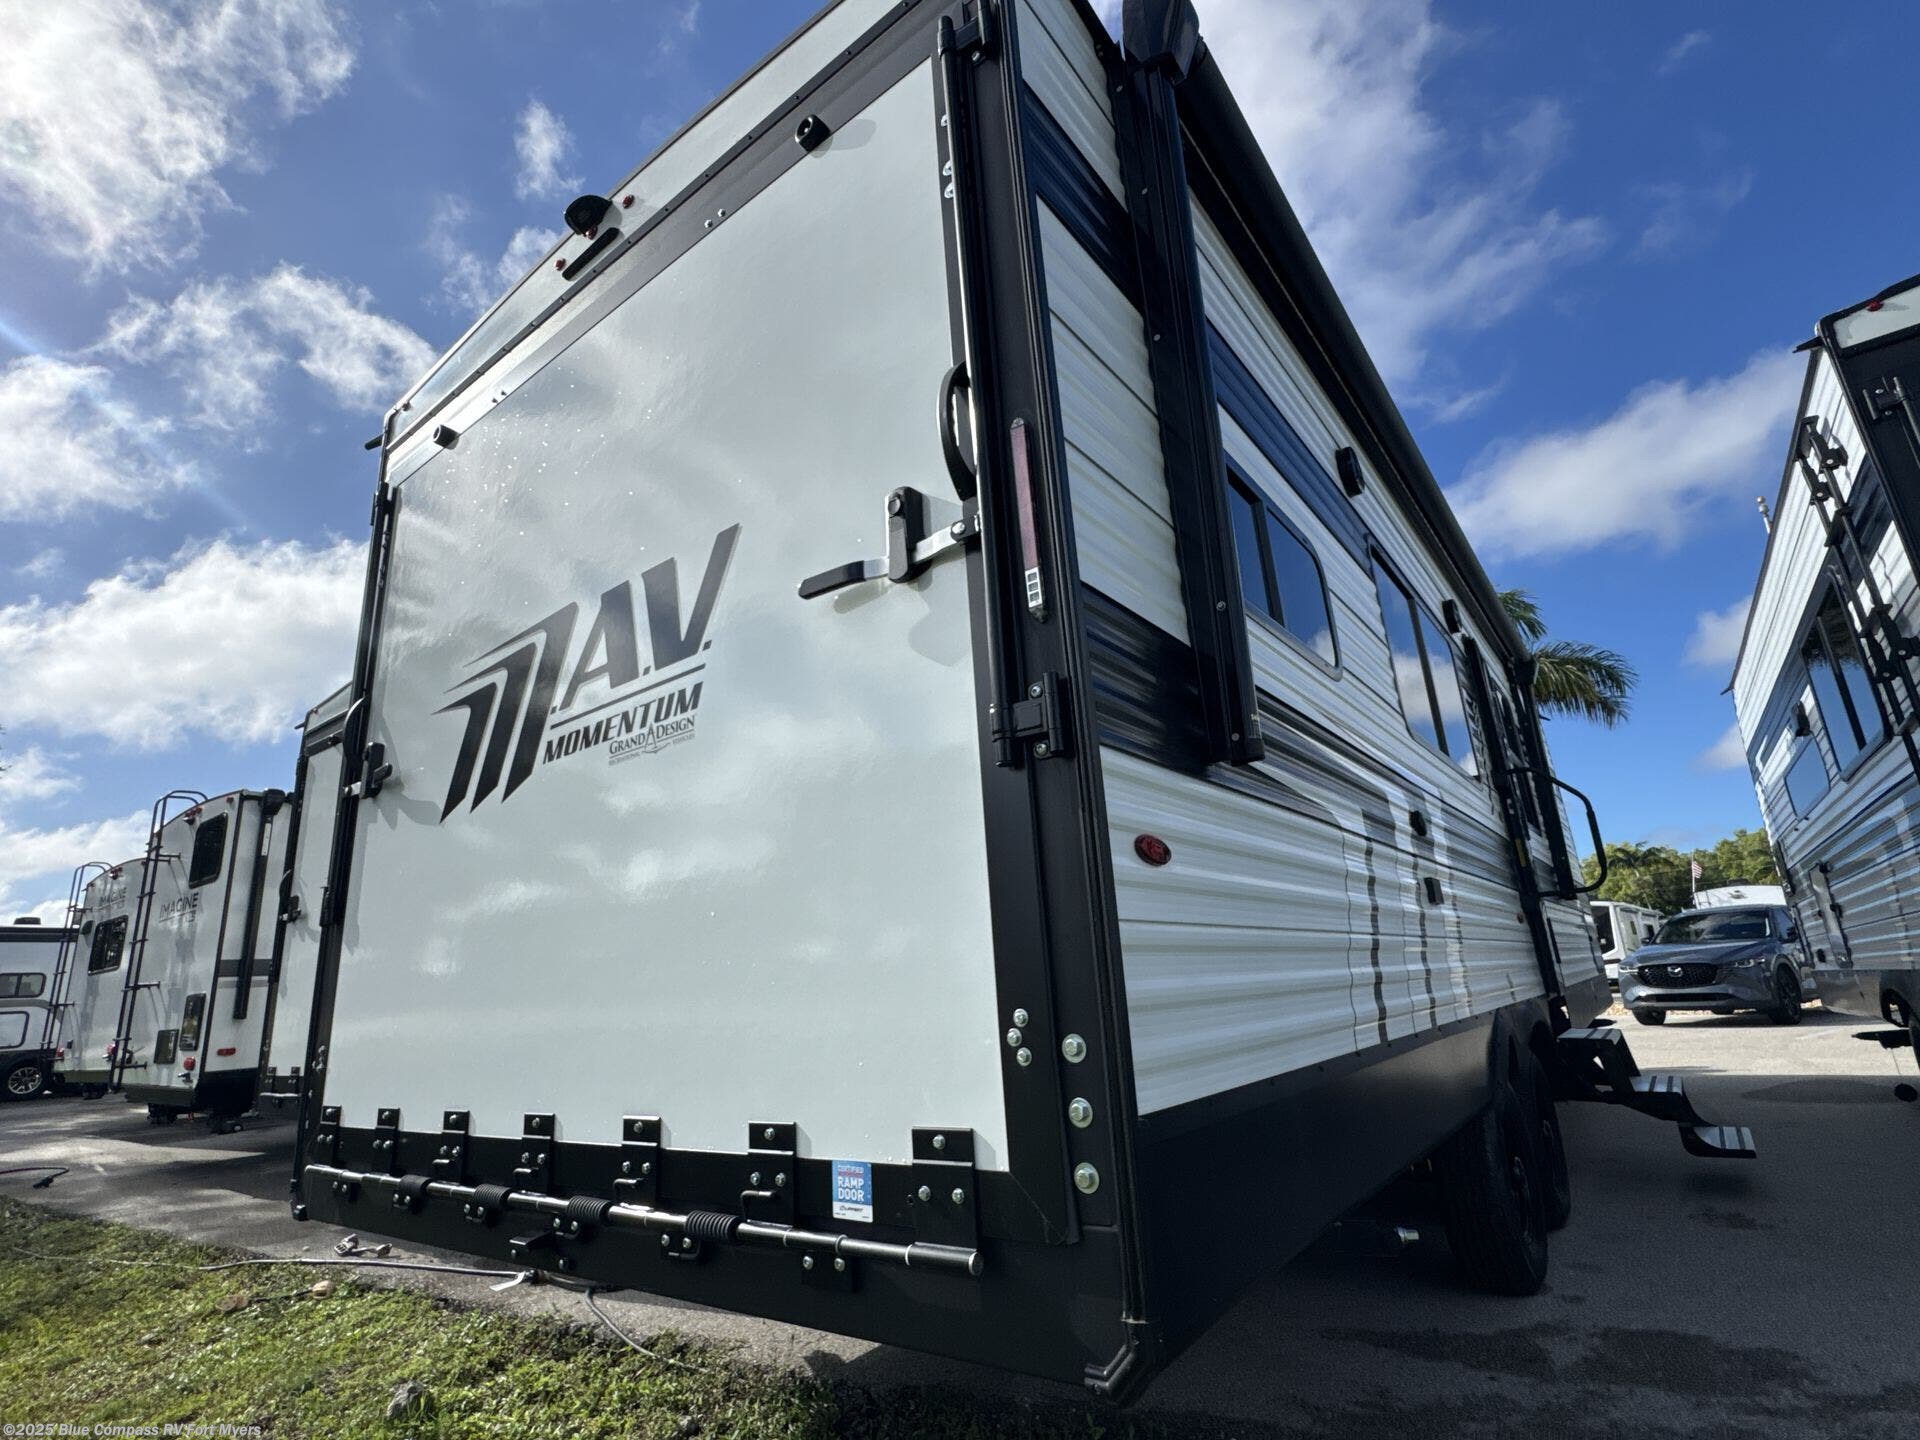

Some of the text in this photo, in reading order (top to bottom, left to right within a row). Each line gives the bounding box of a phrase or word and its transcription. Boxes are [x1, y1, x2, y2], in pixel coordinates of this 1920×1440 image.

[542, 681, 704, 765] MOMENTUM
[609, 715, 695, 755] GRAND DESIGN
[160, 891, 199, 919] IMAGINE
[837, 1176, 865, 1189] RAMP
[837, 1187, 865, 1202] DOOR
